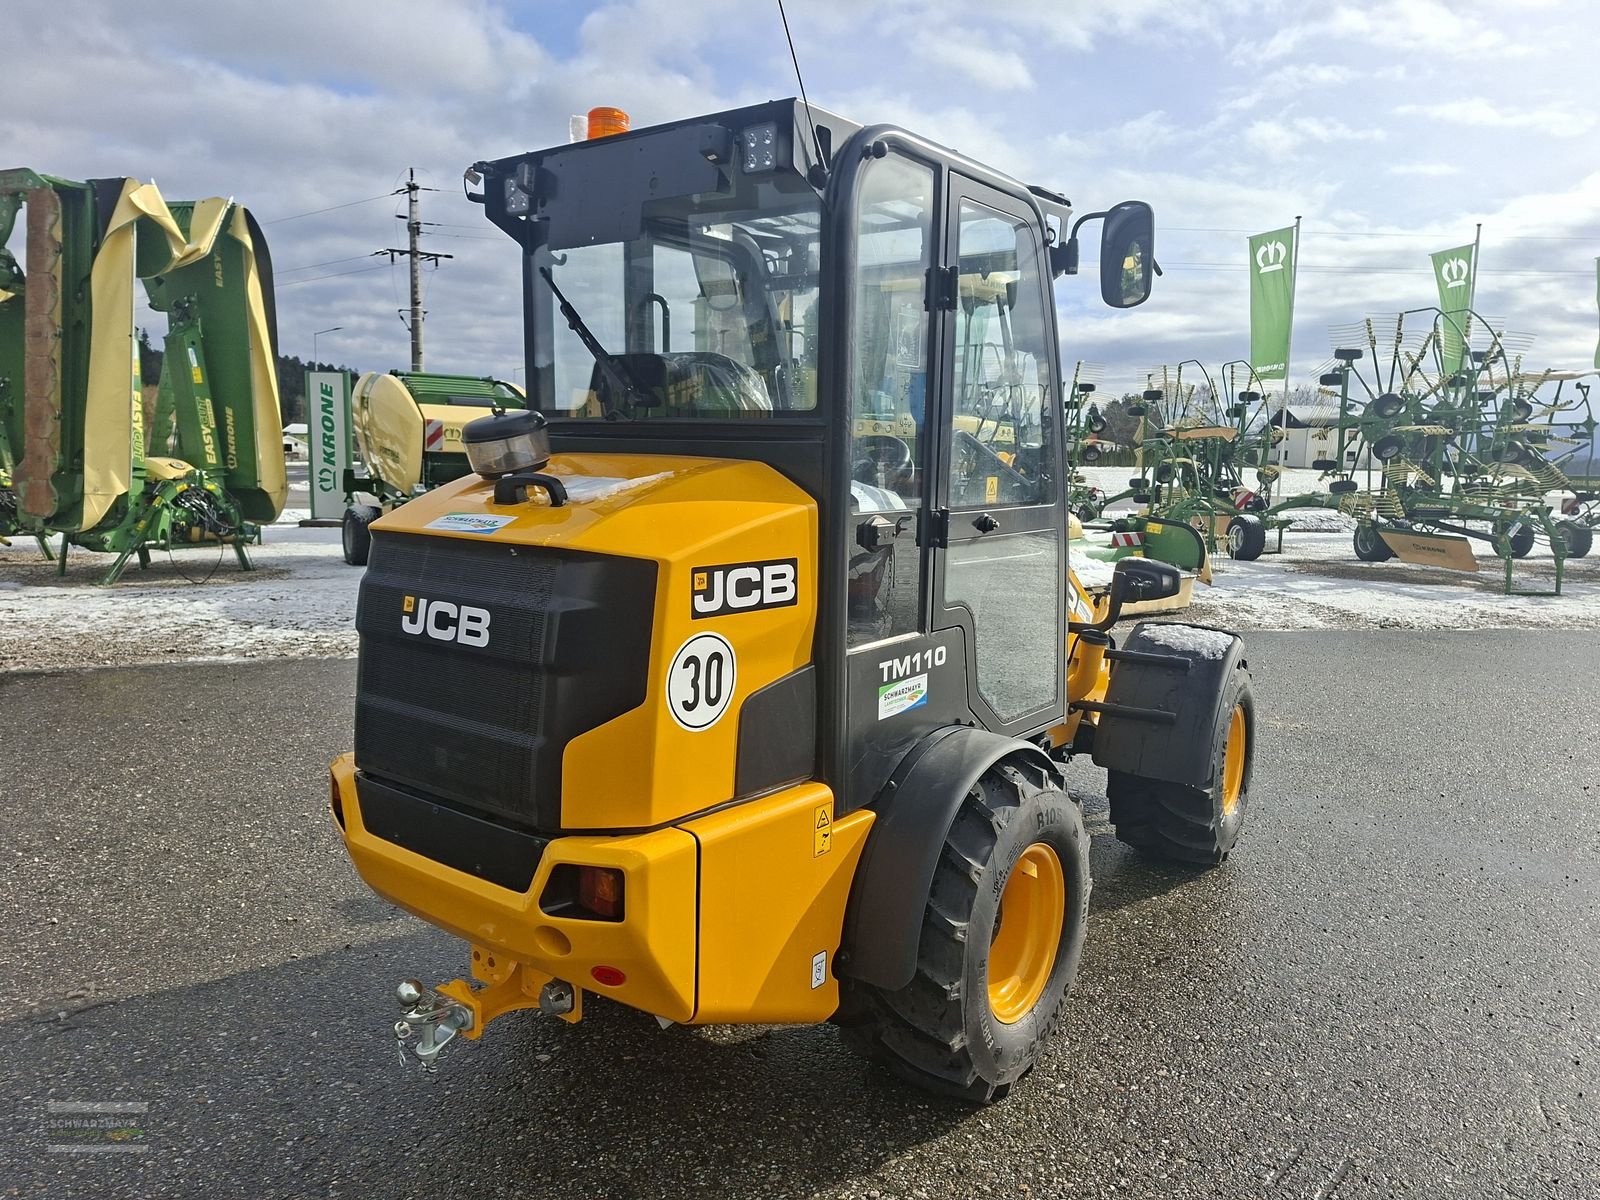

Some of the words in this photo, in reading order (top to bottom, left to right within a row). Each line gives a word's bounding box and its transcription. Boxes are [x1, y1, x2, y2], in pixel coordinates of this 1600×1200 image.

[225, 406, 238, 456] KRONE
[320, 382, 336, 467] KRONE
[694, 564, 796, 613] JCB
[402, 598, 491, 648] JCB
[682, 651, 724, 712] 30
[879, 645, 947, 683] TM110
[884, 682, 922, 701] SCHWARZMAYR
